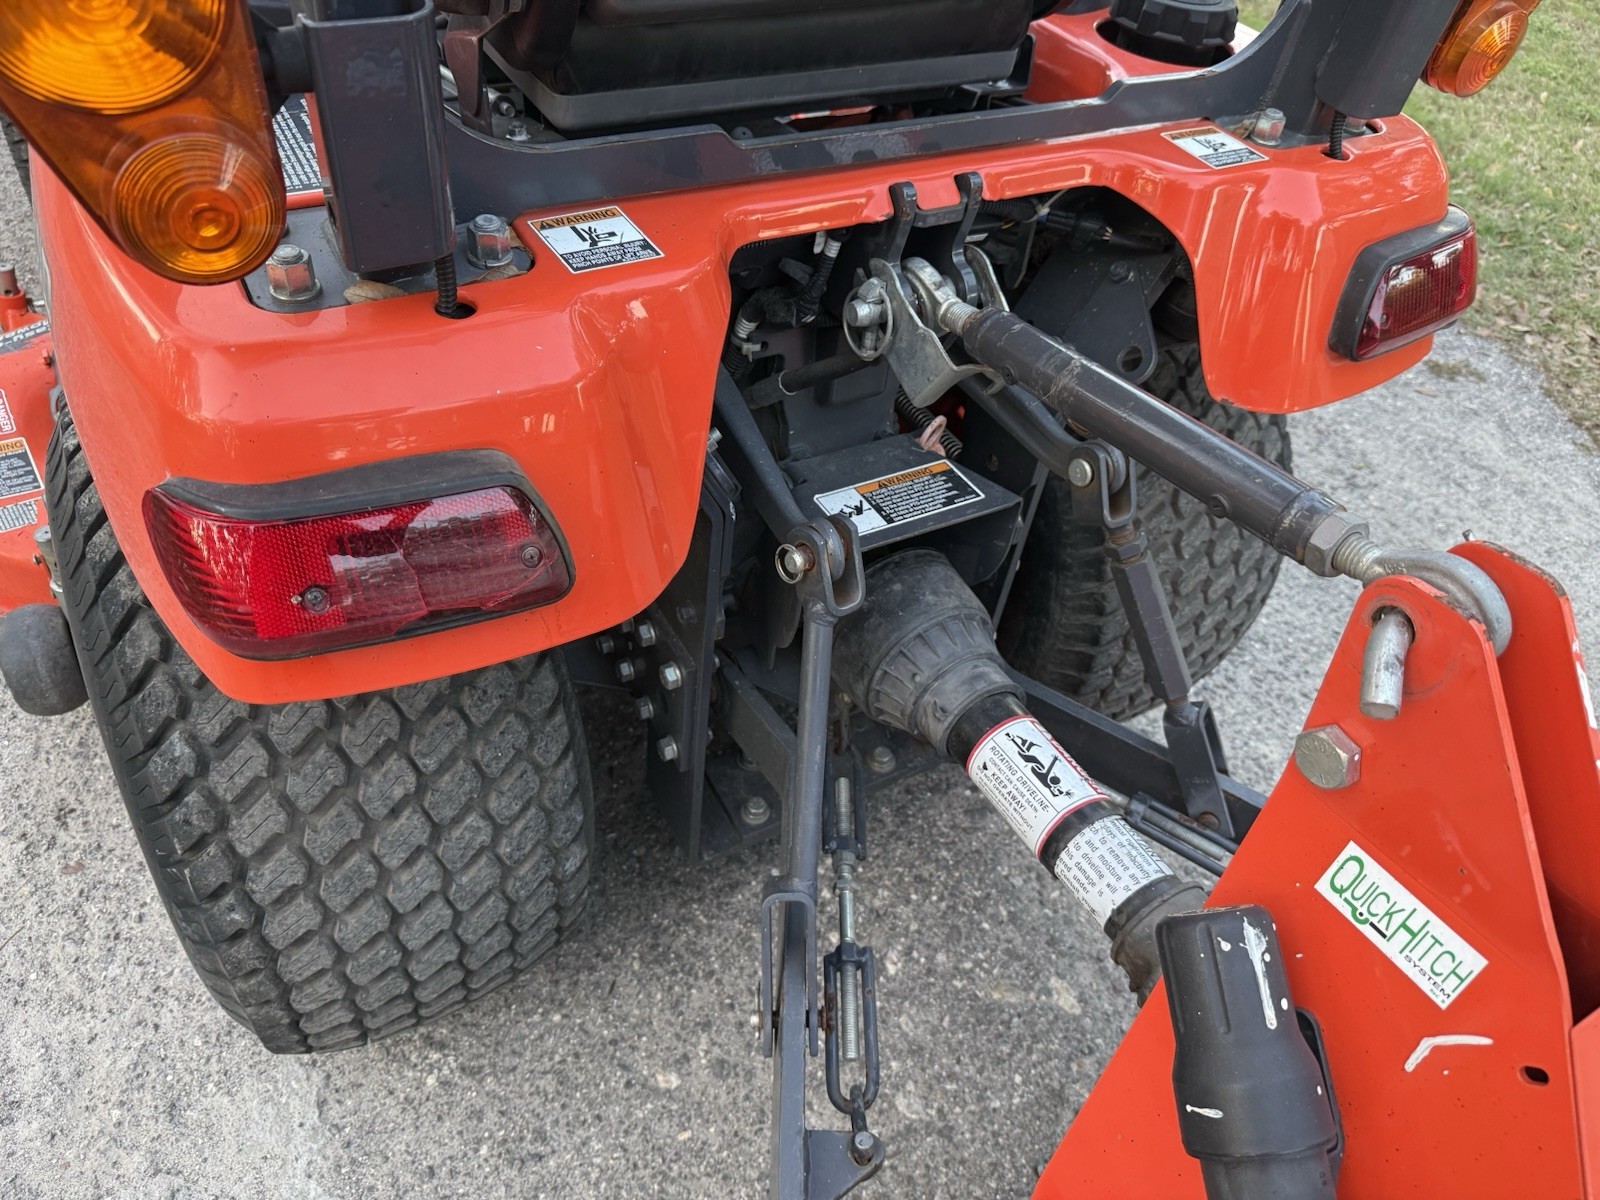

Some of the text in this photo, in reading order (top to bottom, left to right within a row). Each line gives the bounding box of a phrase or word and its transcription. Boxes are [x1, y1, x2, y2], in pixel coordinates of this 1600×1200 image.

[553, 209, 616, 226] WARNING
[884, 468, 932, 485] WARNING
[988, 745, 1018, 776] ROTATING
[988, 756, 1006, 776] CONTACT
[1003, 774, 1014, 785] CAN
[1012, 784, 1026, 799] CAUSE
[976, 764, 984, 773] DO
[982, 771, 993, 784] NOT
[991, 783, 1013, 807] OPERATE
[990, 772, 1008, 790] KEEP
[1005, 789, 1027, 812] AWAY!
[1098, 836, 1108, 845] to
[1106, 846, 1129, 872] remove
[1126, 872, 1141, 887] any
[1116, 840, 1126, 849] of
[1124, 836, 1152, 867] operation
[1057, 856, 1090, 894] ered under
[1072, 860, 1098, 888] damage
[1096, 888, 1105, 897] is
[1080, 851, 1106, 880] driveline
[1104, 880, 1118, 894] will
[1084, 837, 1098, 852] and
[1096, 852, 1123, 882] moisture
[1122, 883, 1131, 893] or
[1404, 954, 1451, 999] SYSTEM
